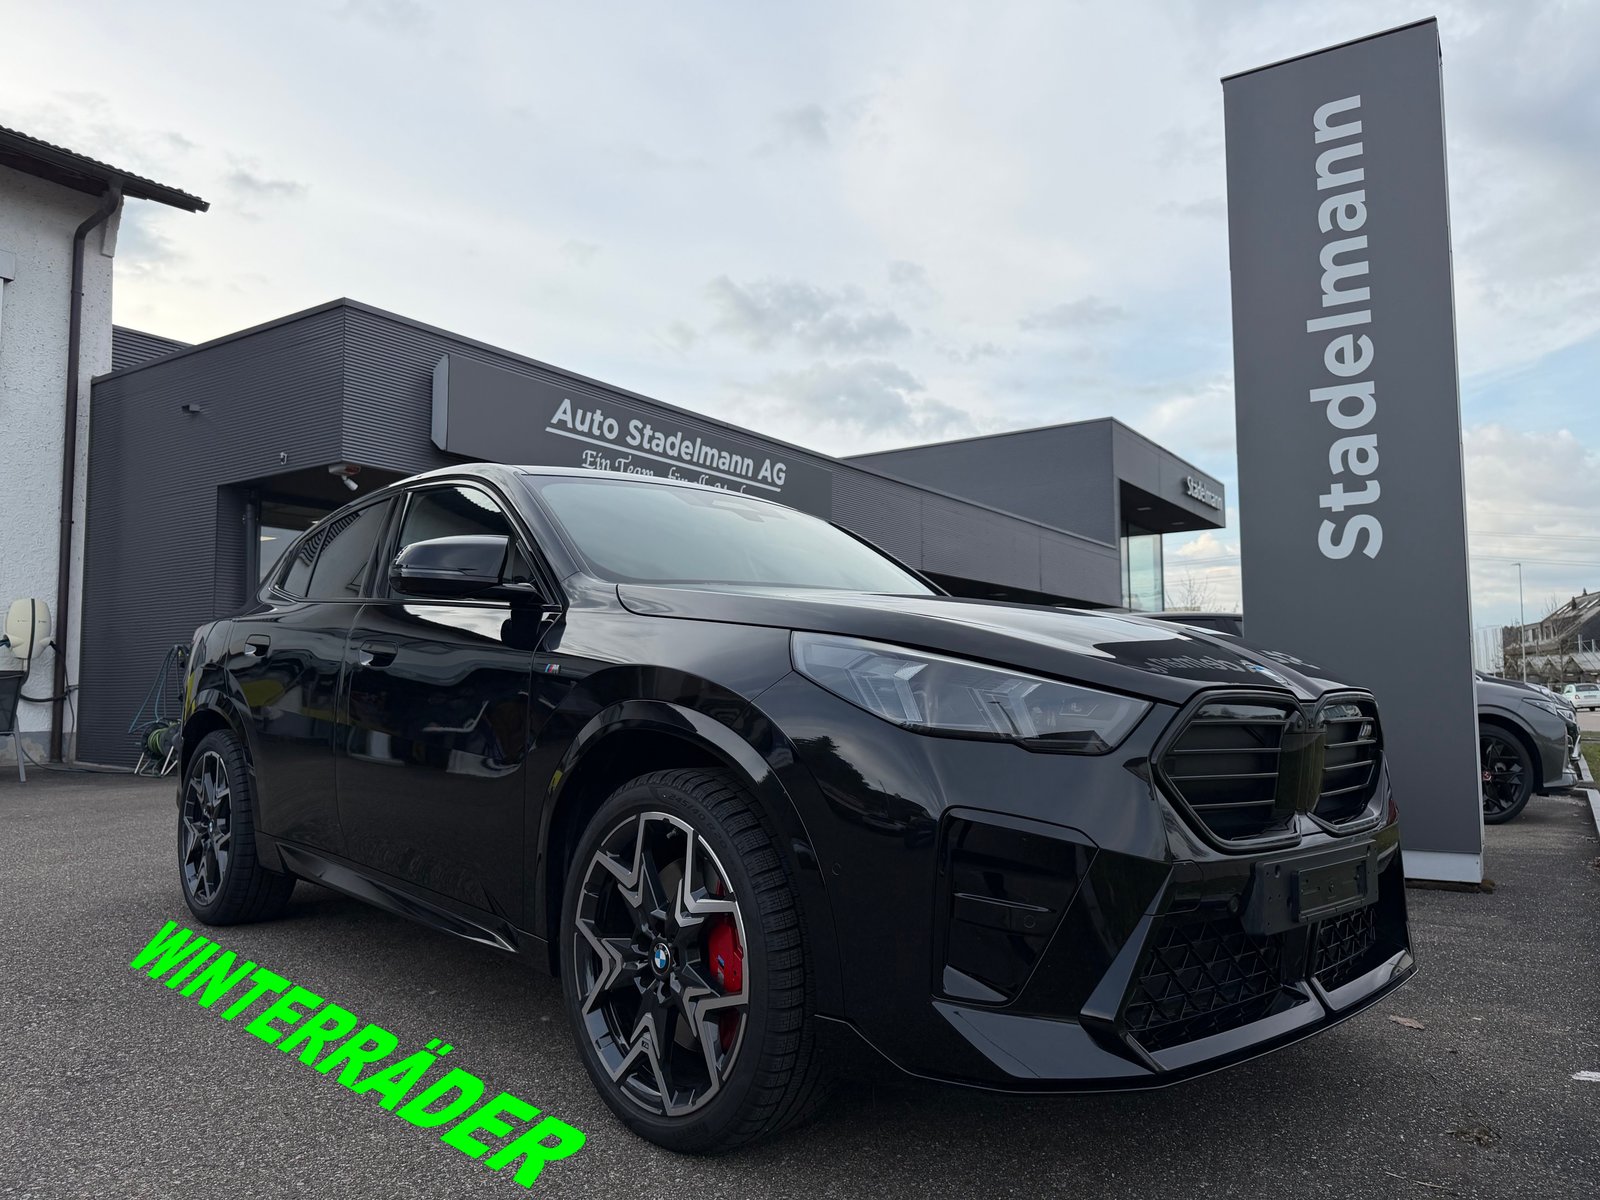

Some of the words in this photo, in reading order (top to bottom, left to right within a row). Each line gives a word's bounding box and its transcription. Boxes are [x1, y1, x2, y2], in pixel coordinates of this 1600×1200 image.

[1306, 94, 1384, 561] Stadelmann
[550, 398, 619, 440] Auto
[625, 419, 754, 477] Stadelmann
[757, 458, 787, 486] AG
[581, 449, 611, 471] Ein
